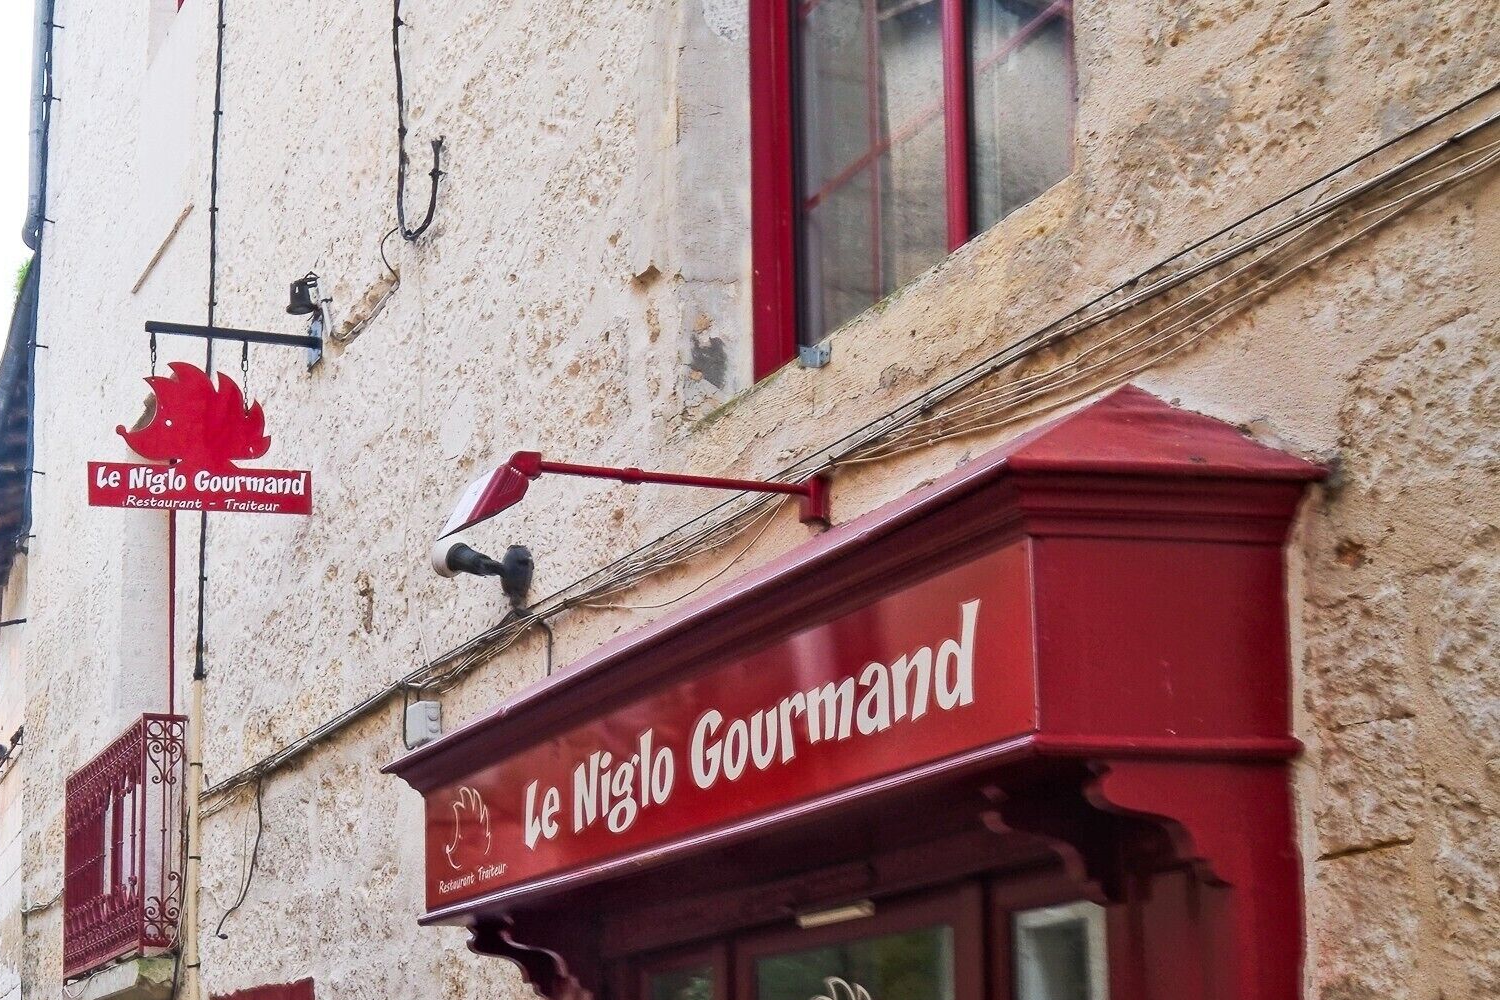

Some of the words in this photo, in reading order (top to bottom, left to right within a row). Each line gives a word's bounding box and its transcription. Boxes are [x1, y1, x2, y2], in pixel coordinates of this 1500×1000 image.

[96, 465, 121, 489] Le
[129, 466, 187, 494] Niglo
[194, 470, 306, 496] Gourmand
[126, 494, 202, 509] Restaurant
[224, 498, 280, 511] Traiteur
[523, 778, 560, 851] Le
[572, 727, 675, 834] Niglo
[691, 598, 981, 788] Gourmand
[439, 871, 475, 894] Restaurant
[478, 863, 507, 881] Traiteur
